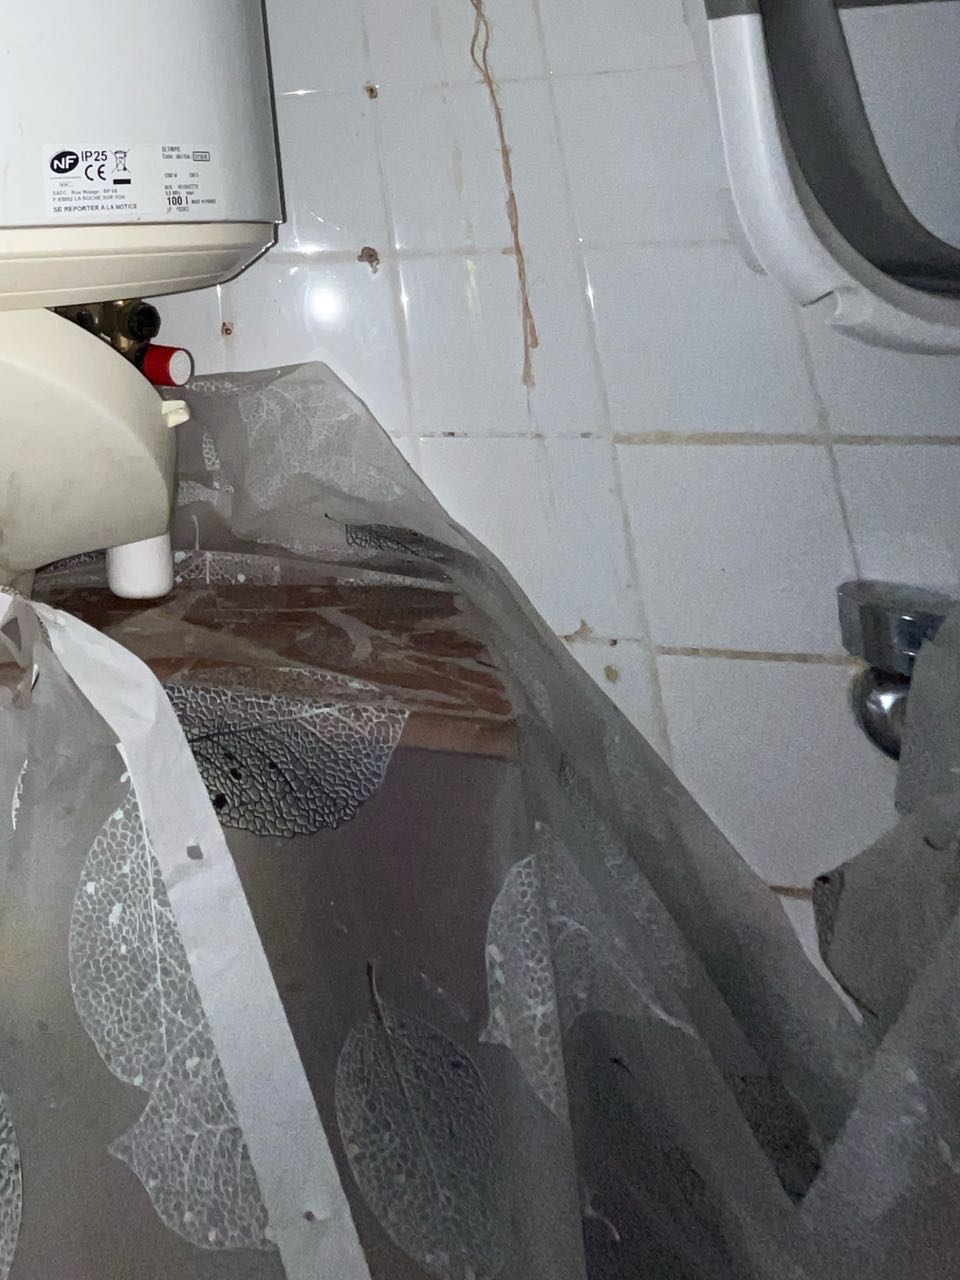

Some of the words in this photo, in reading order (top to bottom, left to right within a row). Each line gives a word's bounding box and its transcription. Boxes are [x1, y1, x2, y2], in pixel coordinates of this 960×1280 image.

[81, 150, 108, 162] IP25
[53, 155, 77, 170] NF
[84, 164, 106, 181] CE
[167, 196, 182, 205] 100
[64, 204, 100, 212] REPORTER
